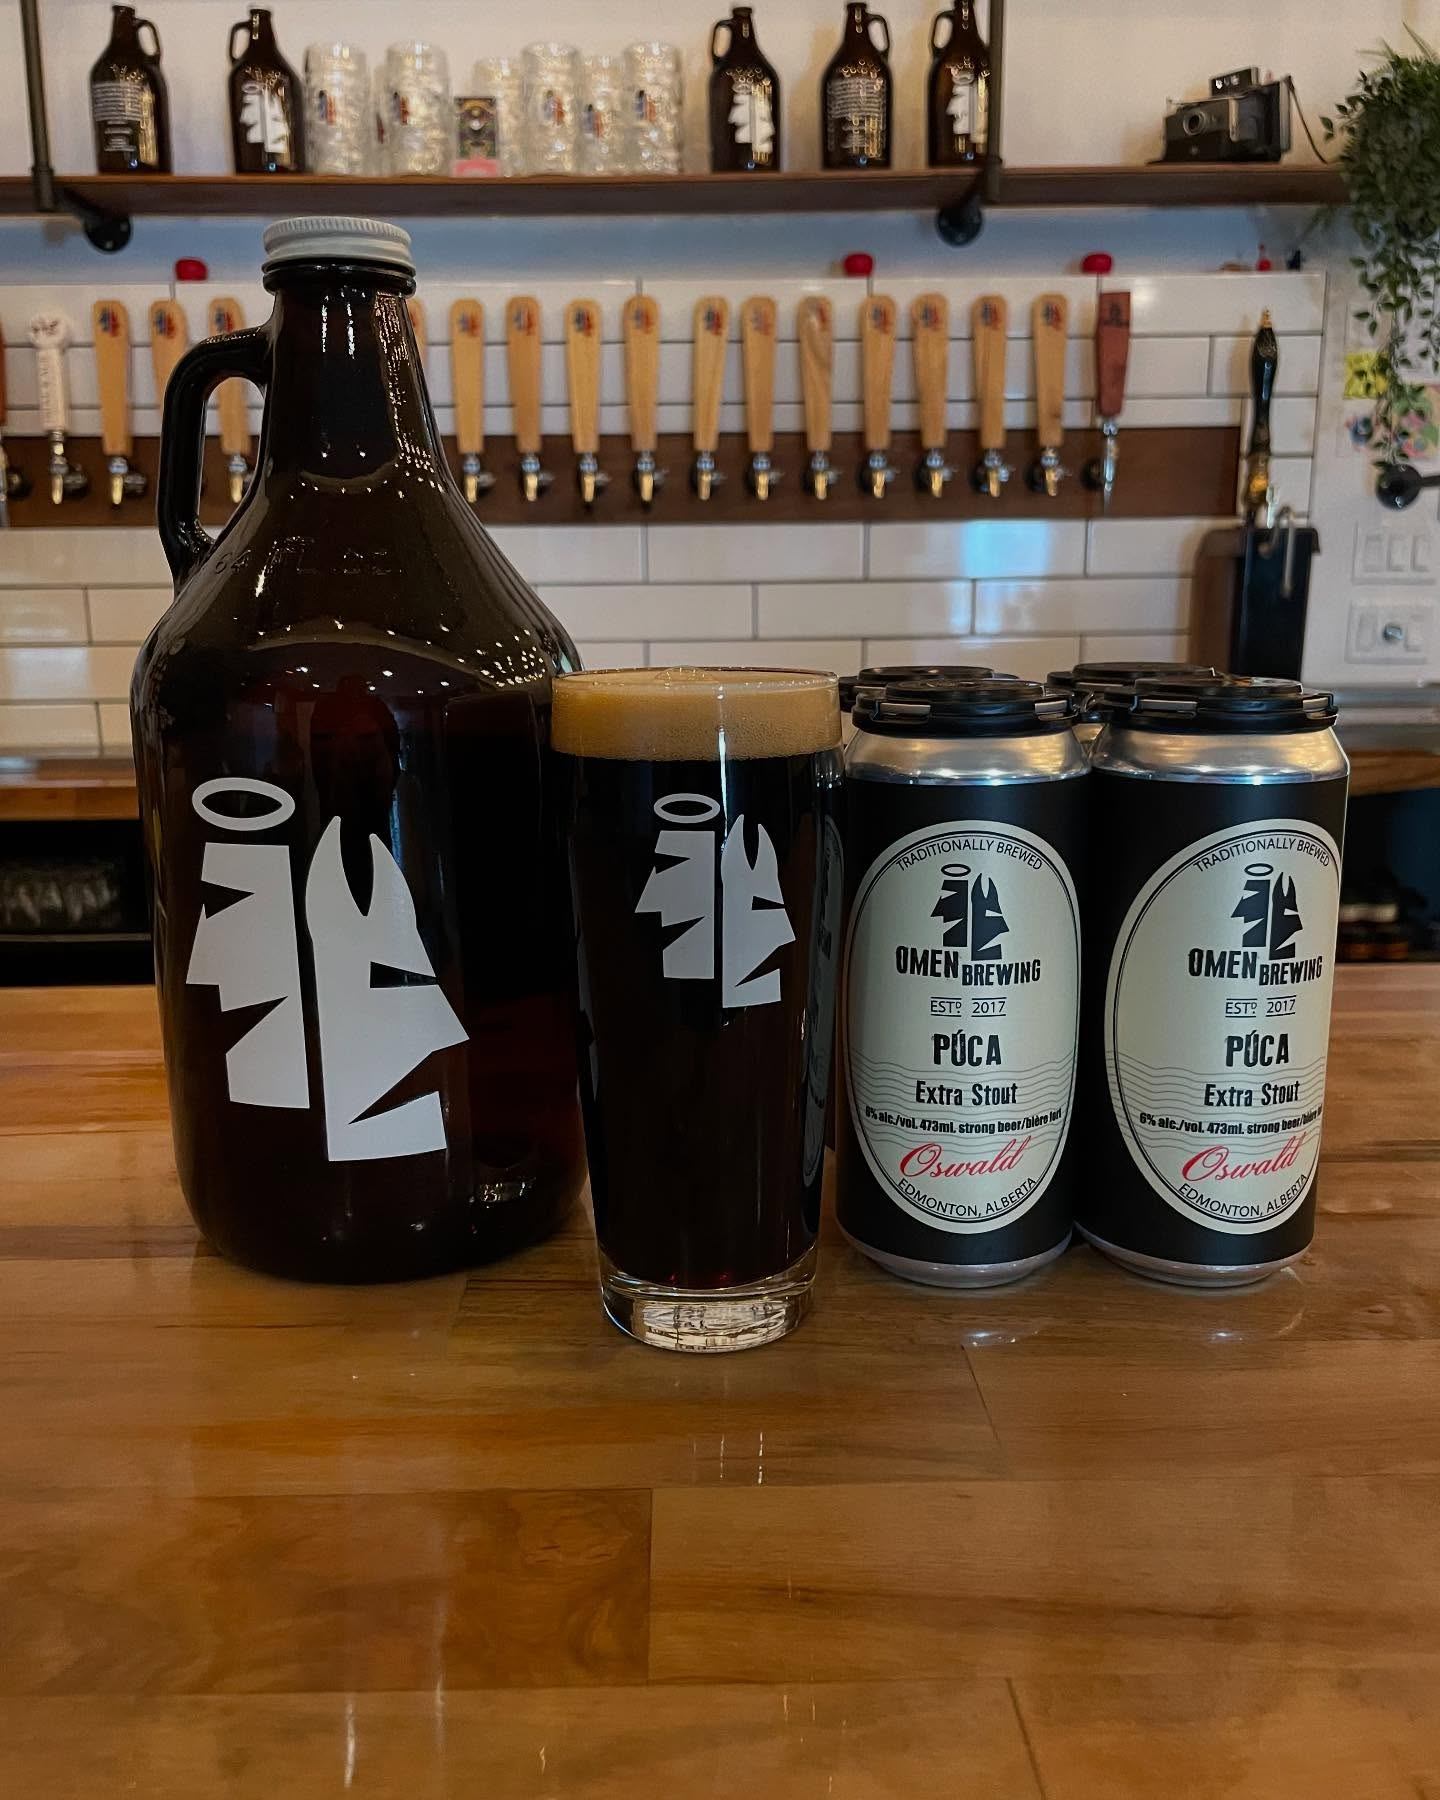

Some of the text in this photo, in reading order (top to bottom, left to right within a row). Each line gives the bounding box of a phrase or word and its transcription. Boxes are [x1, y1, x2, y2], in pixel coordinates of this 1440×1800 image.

[896, 839, 1043, 872] TRADITIONALLY BREWED
[1193, 838, 1330, 872] TRADITIONALLY BREWED
[896, 946, 1041, 986] OMEN BREWING
[1188, 948, 1323, 986] OMEN BREWING
[972, 1001, 1006, 1013] 2017
[1266, 999, 1296, 1013] 2017
[932, 1029, 1002, 1066] PÚCA
[1224, 1029, 1290, 1067] PÚCA
[915, 1080, 1018, 1105] Extra Stout
[1203, 1080, 1300, 1107] Extra Stout
[865, 1105, 878, 1119] 6%
[879, 1112, 918, 1129] alc./vol.
[958, 1122, 995, 1134] strong
[1139, 1112, 1156, 1126] 6%
[1158, 1117, 1205, 1133] alc./vol.
[1247, 1122, 1280, 1134] strong
[899, 1135, 1032, 1178] Oswald
[1181, 1131, 1307, 1182] Oswald
[898, 1177, 1038, 1217] EDMONTON, ALBERTA
[1178, 1173, 1309, 1218] EDMONTON, ALBERTA
